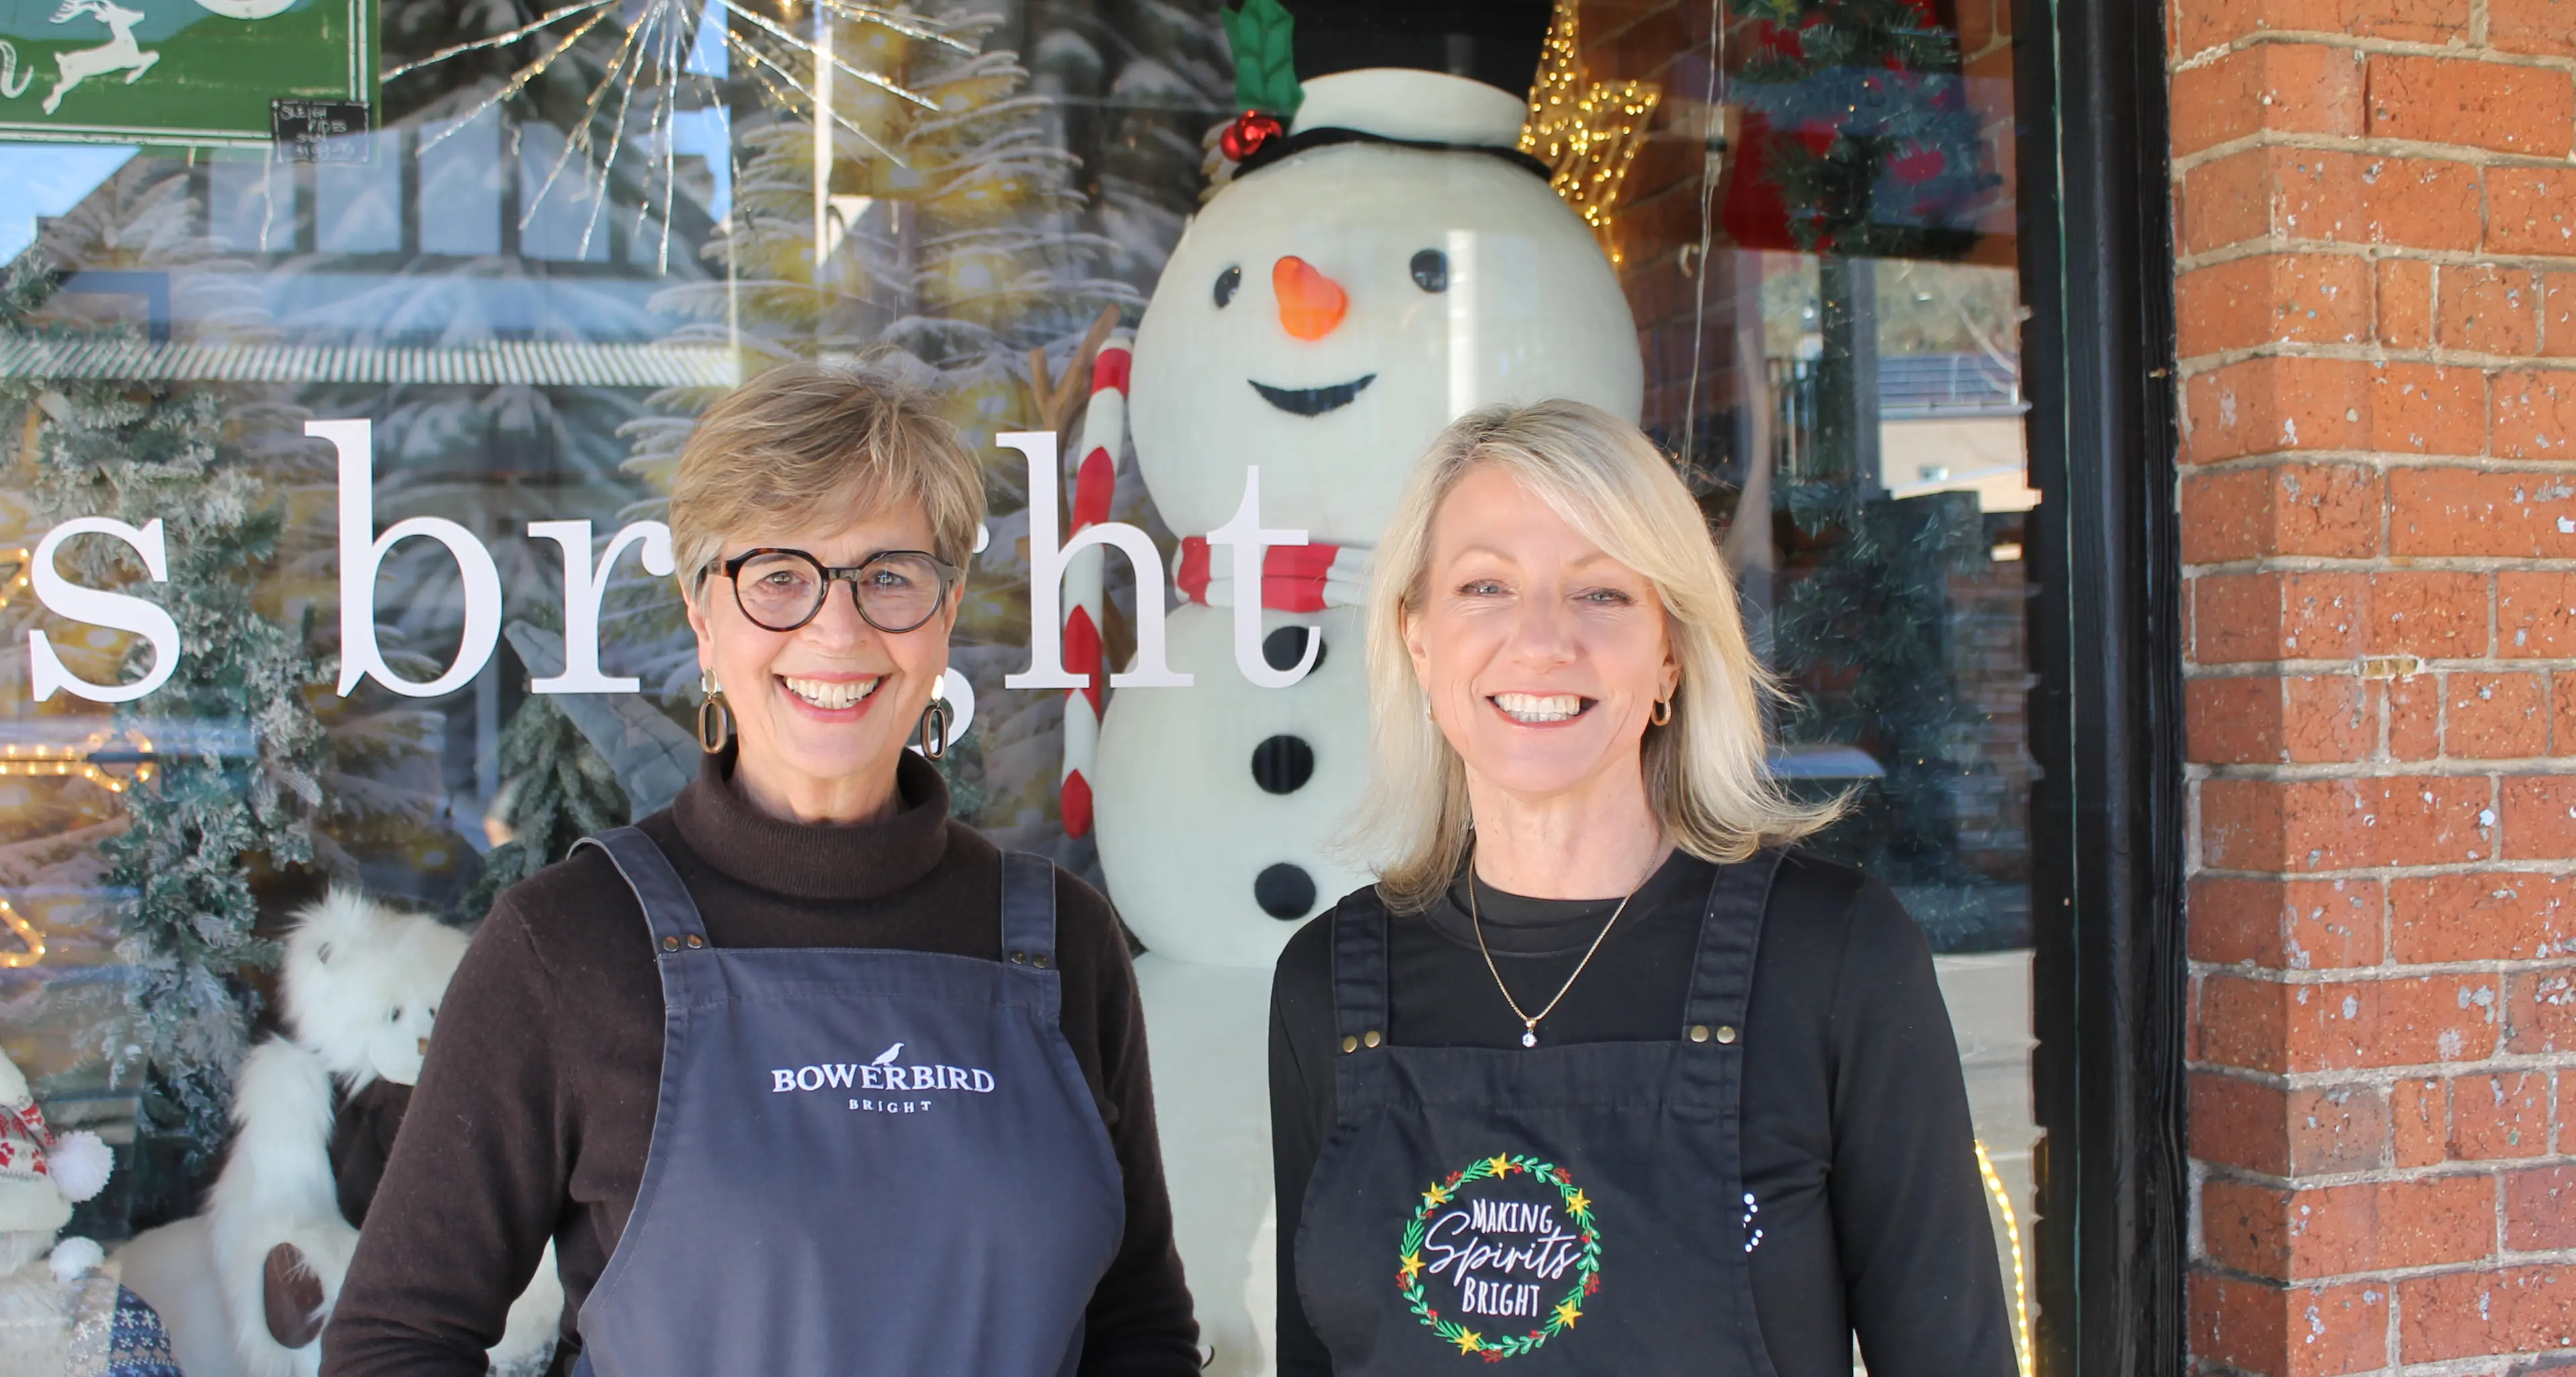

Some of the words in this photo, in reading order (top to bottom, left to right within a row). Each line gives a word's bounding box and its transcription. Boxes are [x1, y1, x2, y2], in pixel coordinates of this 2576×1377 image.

[308, 119, 347, 133] RIDES
[305, 418, 1321, 758] brht
[771, 1064, 996, 1093] BOWERBIRD
[849, 1099, 932, 1113] BRIGHT
[1471, 1199, 1553, 1234] MAKING
[1425, 1211, 1581, 1286] Spirits
[1462, 1276, 1540, 1317] BRIGHT
